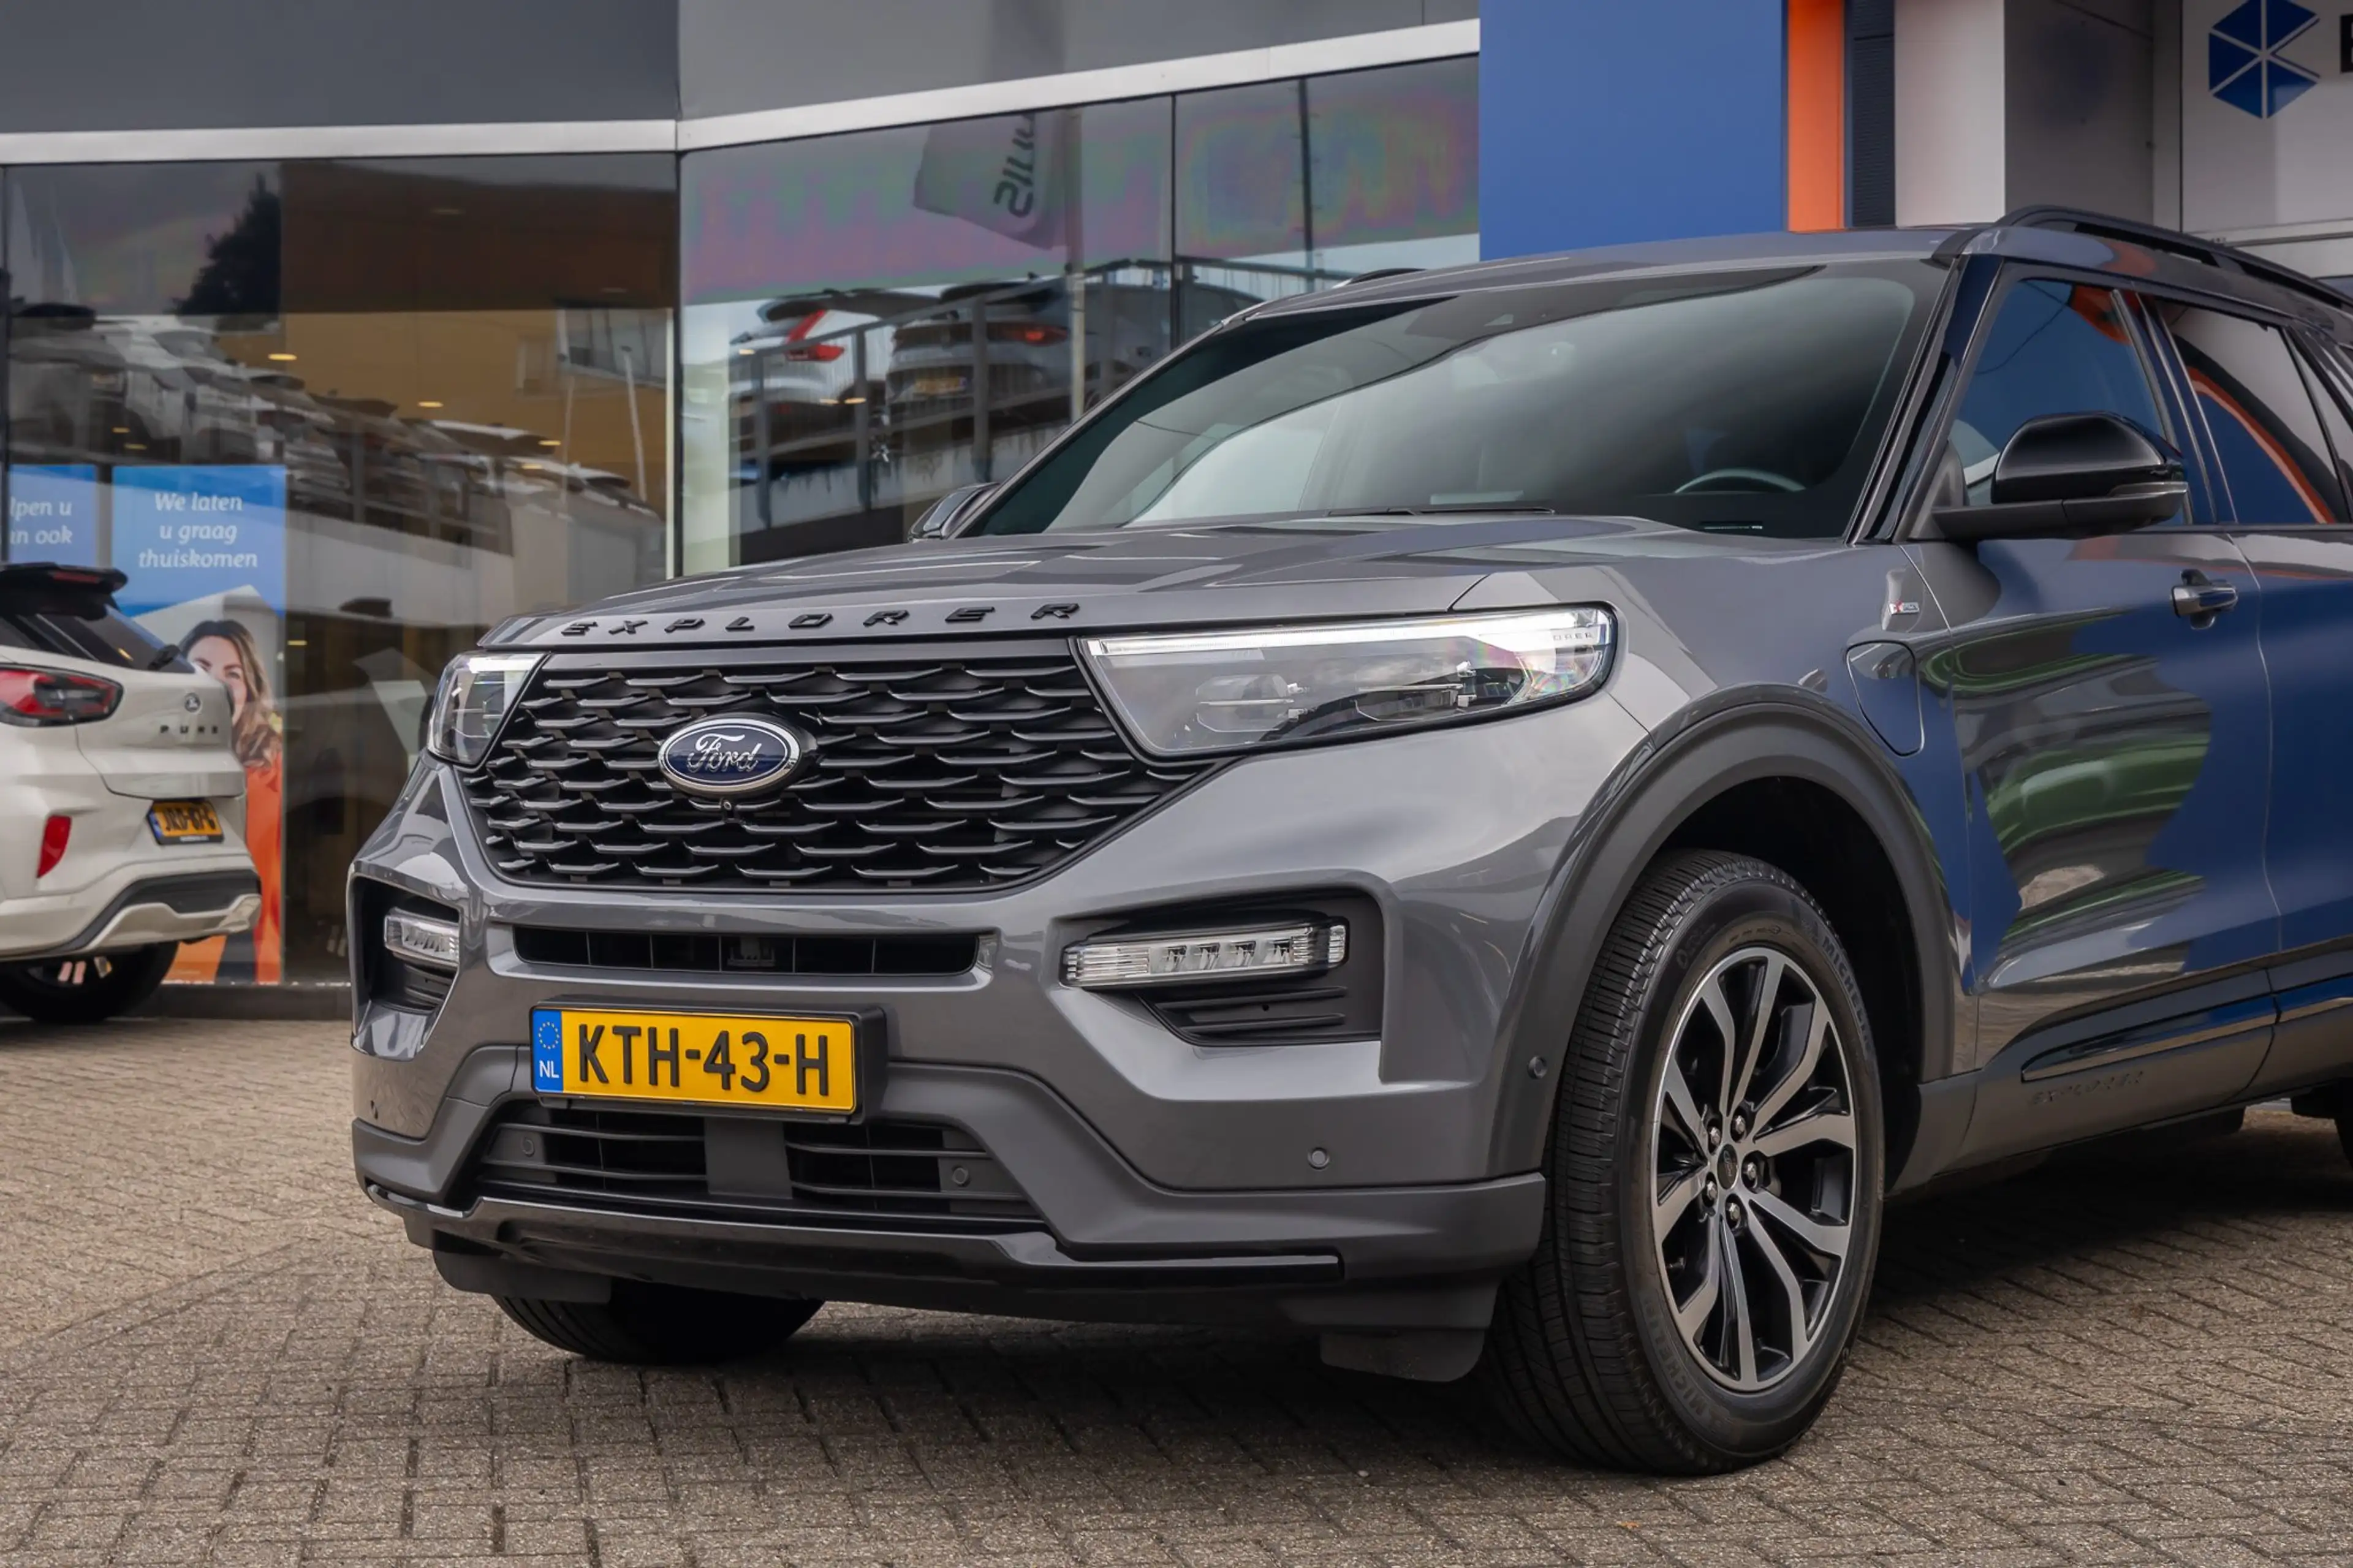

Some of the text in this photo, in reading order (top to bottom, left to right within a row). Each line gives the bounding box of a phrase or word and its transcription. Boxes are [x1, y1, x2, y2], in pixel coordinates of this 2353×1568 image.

[59, 501, 72, 517] u
[155, 492, 243, 511] We laten
[35, 524, 73, 545] ook
[159, 525, 238, 545] u graag
[138, 548, 258, 568] thuiskomen
[560, 602, 1081, 638] EXPLORER
[686, 733, 762, 773] Ford
[539, 1023, 830, 1097] NL KTH-43-H
